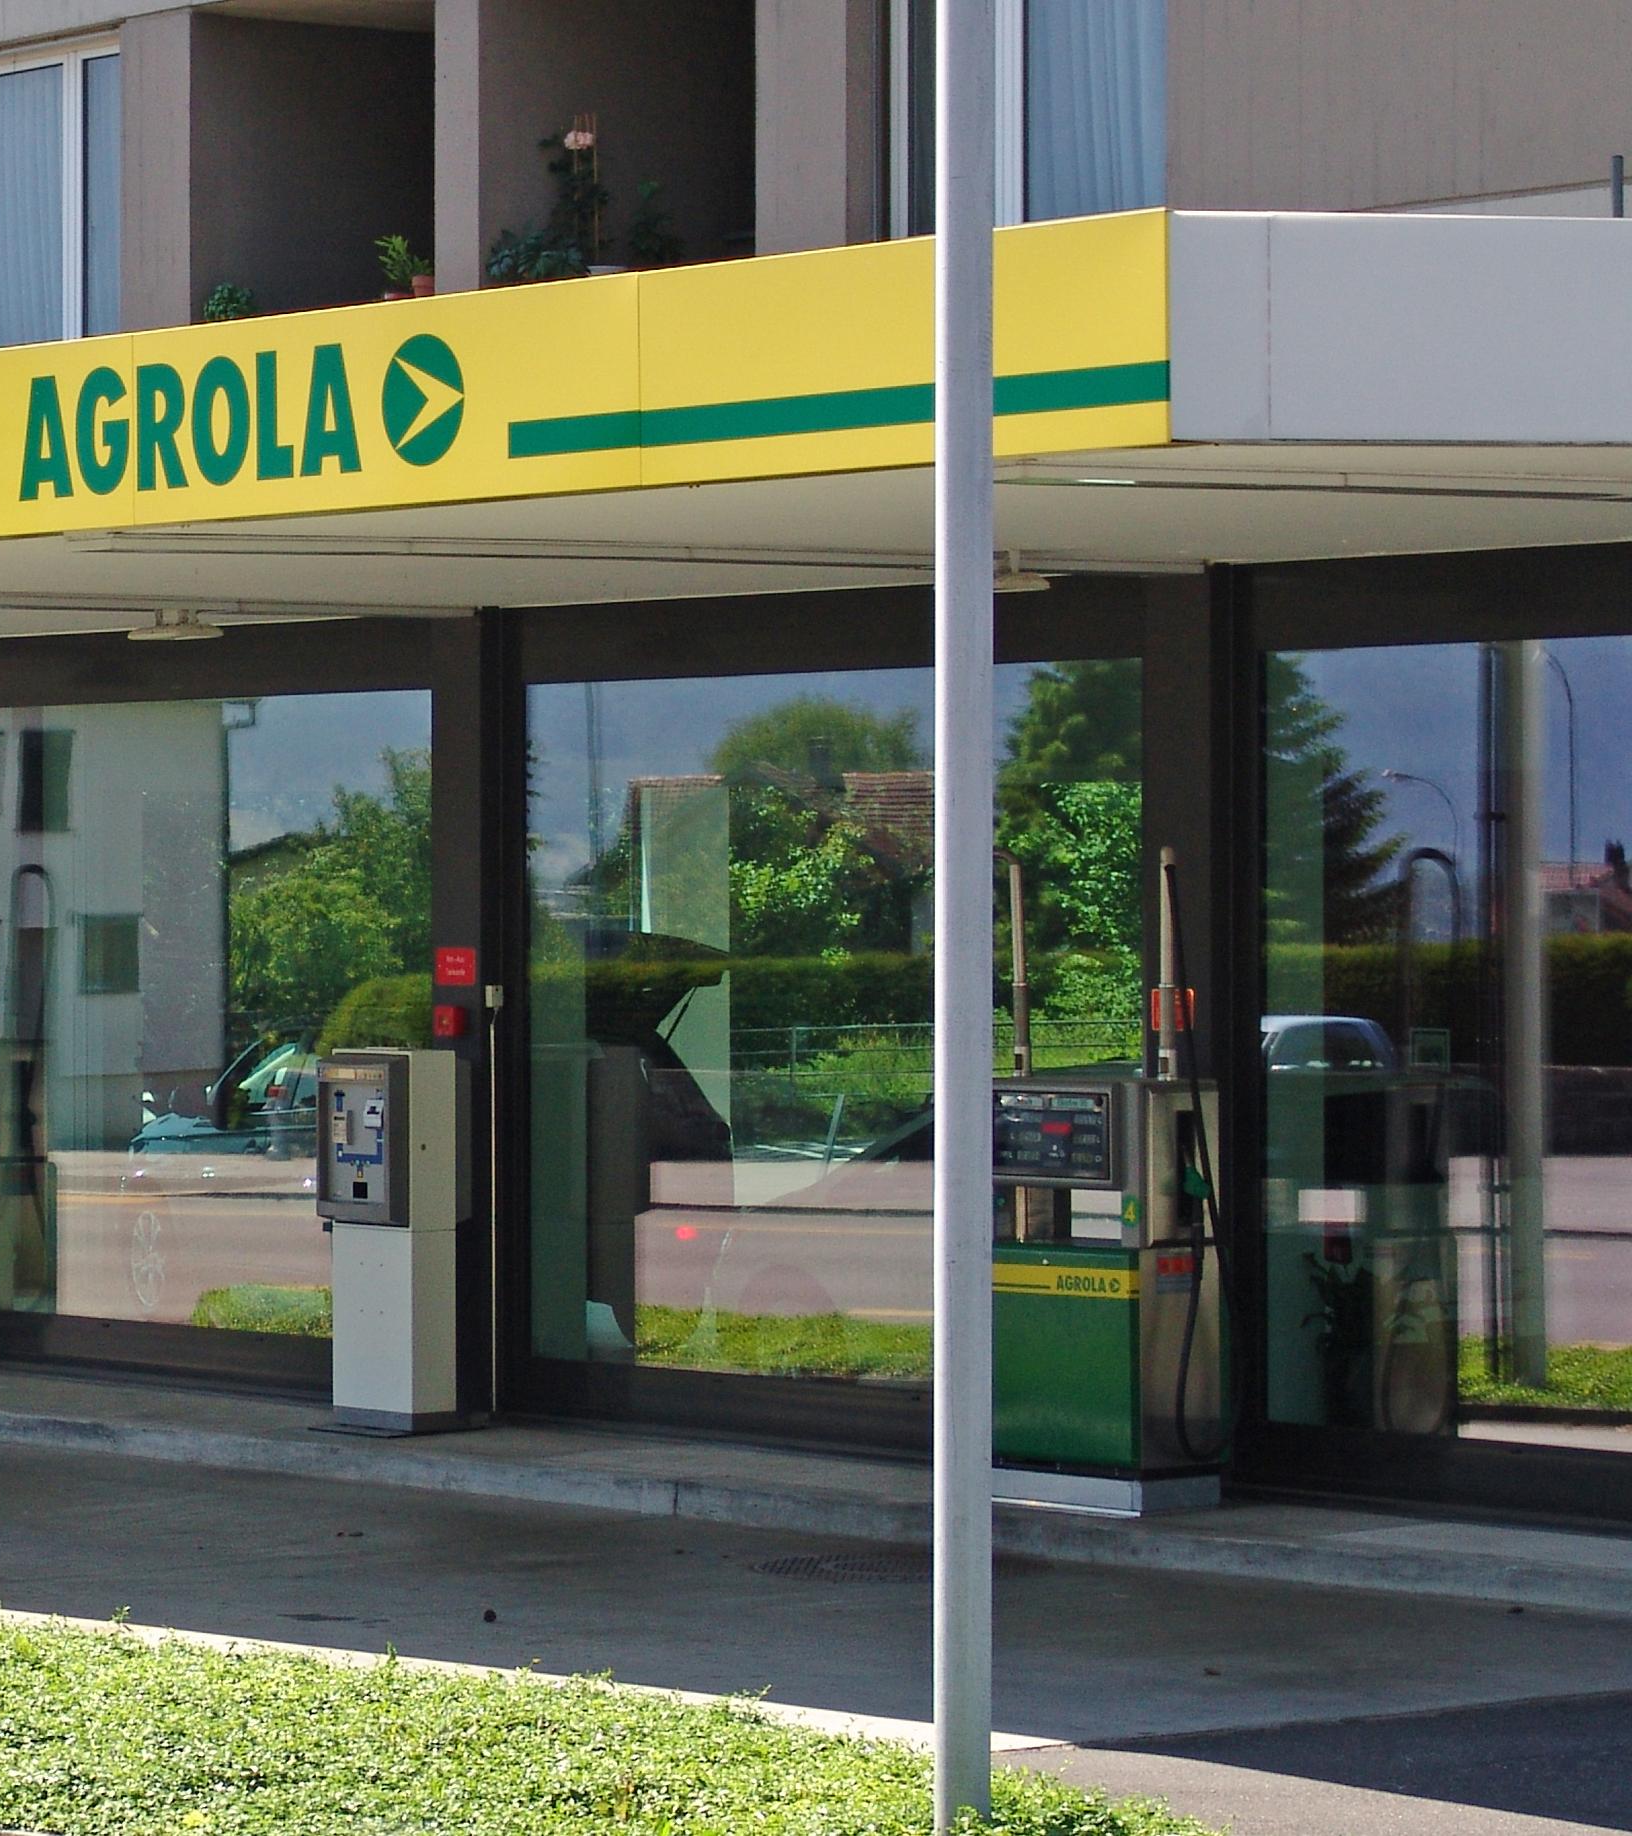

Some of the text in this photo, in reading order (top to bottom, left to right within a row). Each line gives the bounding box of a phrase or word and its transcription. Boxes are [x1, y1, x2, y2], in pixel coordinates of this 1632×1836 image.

[18, 342, 363, 502] AGROLA
[1124, 1201, 1137, 1223] 4
[1056, 1275, 1107, 1293] AGROLA
